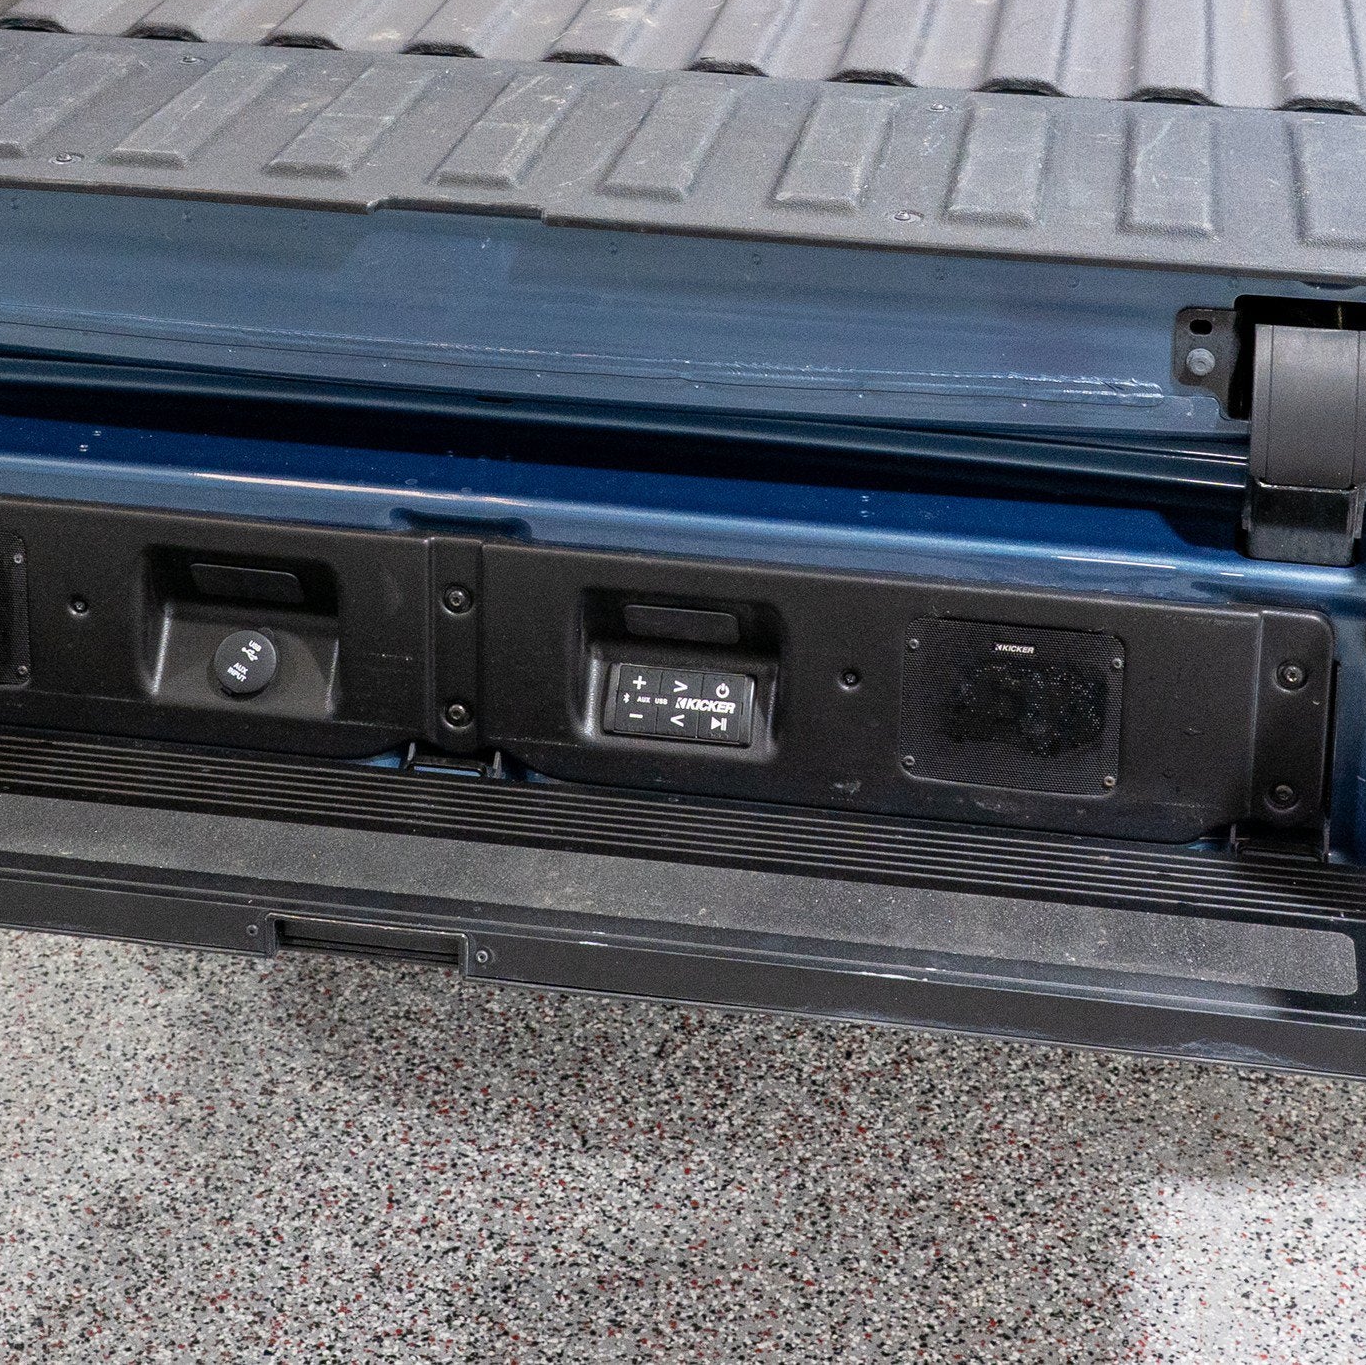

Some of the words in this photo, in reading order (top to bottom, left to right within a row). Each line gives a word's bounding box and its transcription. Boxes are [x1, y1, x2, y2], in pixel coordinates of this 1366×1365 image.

[248, 639, 262, 652] USB
[995, 643, 1035, 654] KICKER
[227, 666, 247, 682] INPUT
[233, 662, 249, 675] AUX
[636, 695, 651, 704] AUX
[654, 697, 668, 705] USB
[676, 697, 736, 714] KICKER
